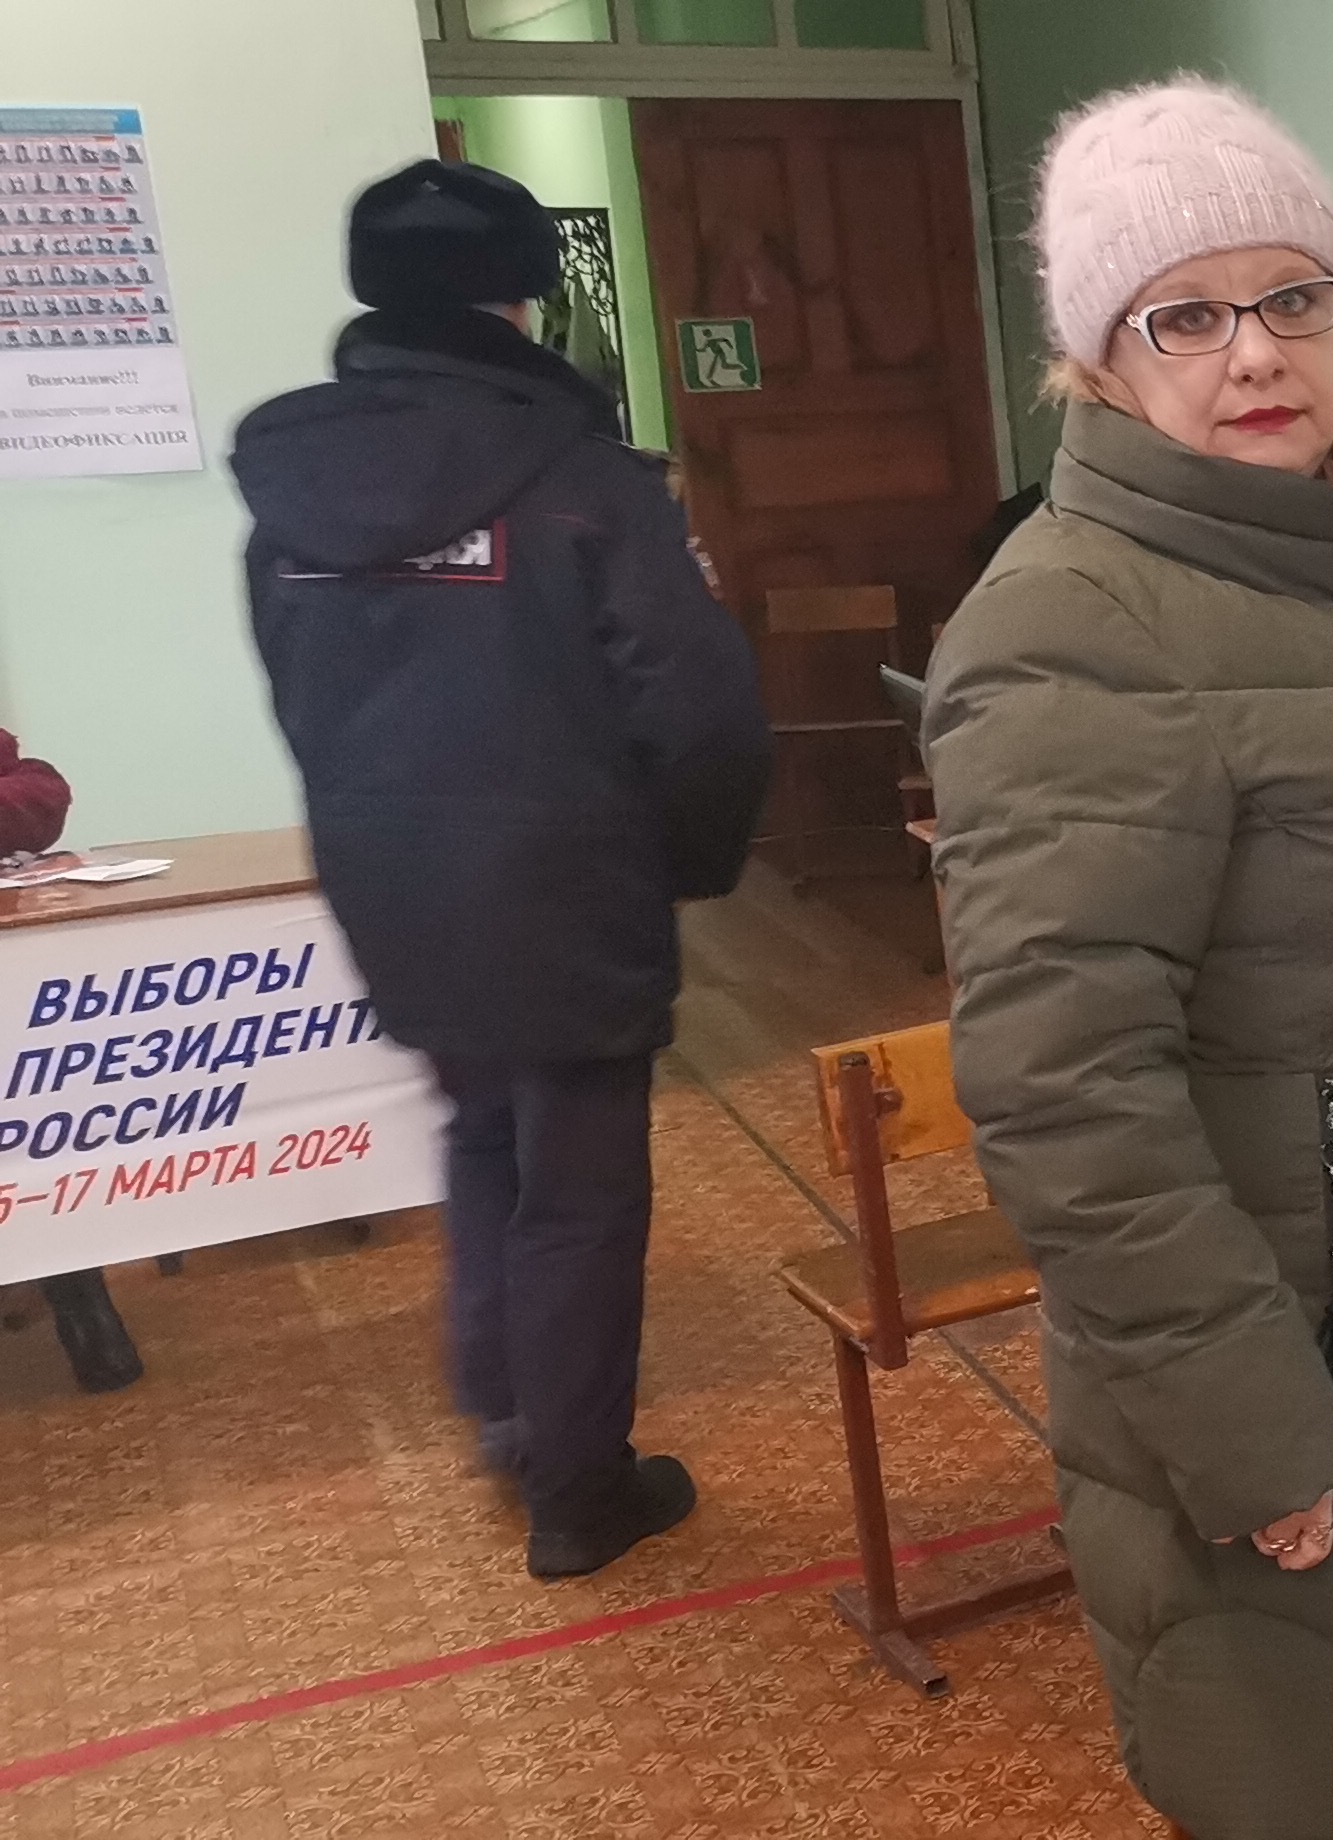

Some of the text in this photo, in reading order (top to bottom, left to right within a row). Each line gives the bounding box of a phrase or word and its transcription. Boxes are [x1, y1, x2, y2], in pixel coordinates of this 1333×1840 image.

[27, 942, 316, 1030] ВЫБОРЫ
[5, 1000, 383, 1100] ПРЕЗИДЕНТ
[0, 1082, 247, 1160] РОССИИ
[104, 1139, 257, 1206] МАРТА
[268, 1120, 373, 1177] 2024
